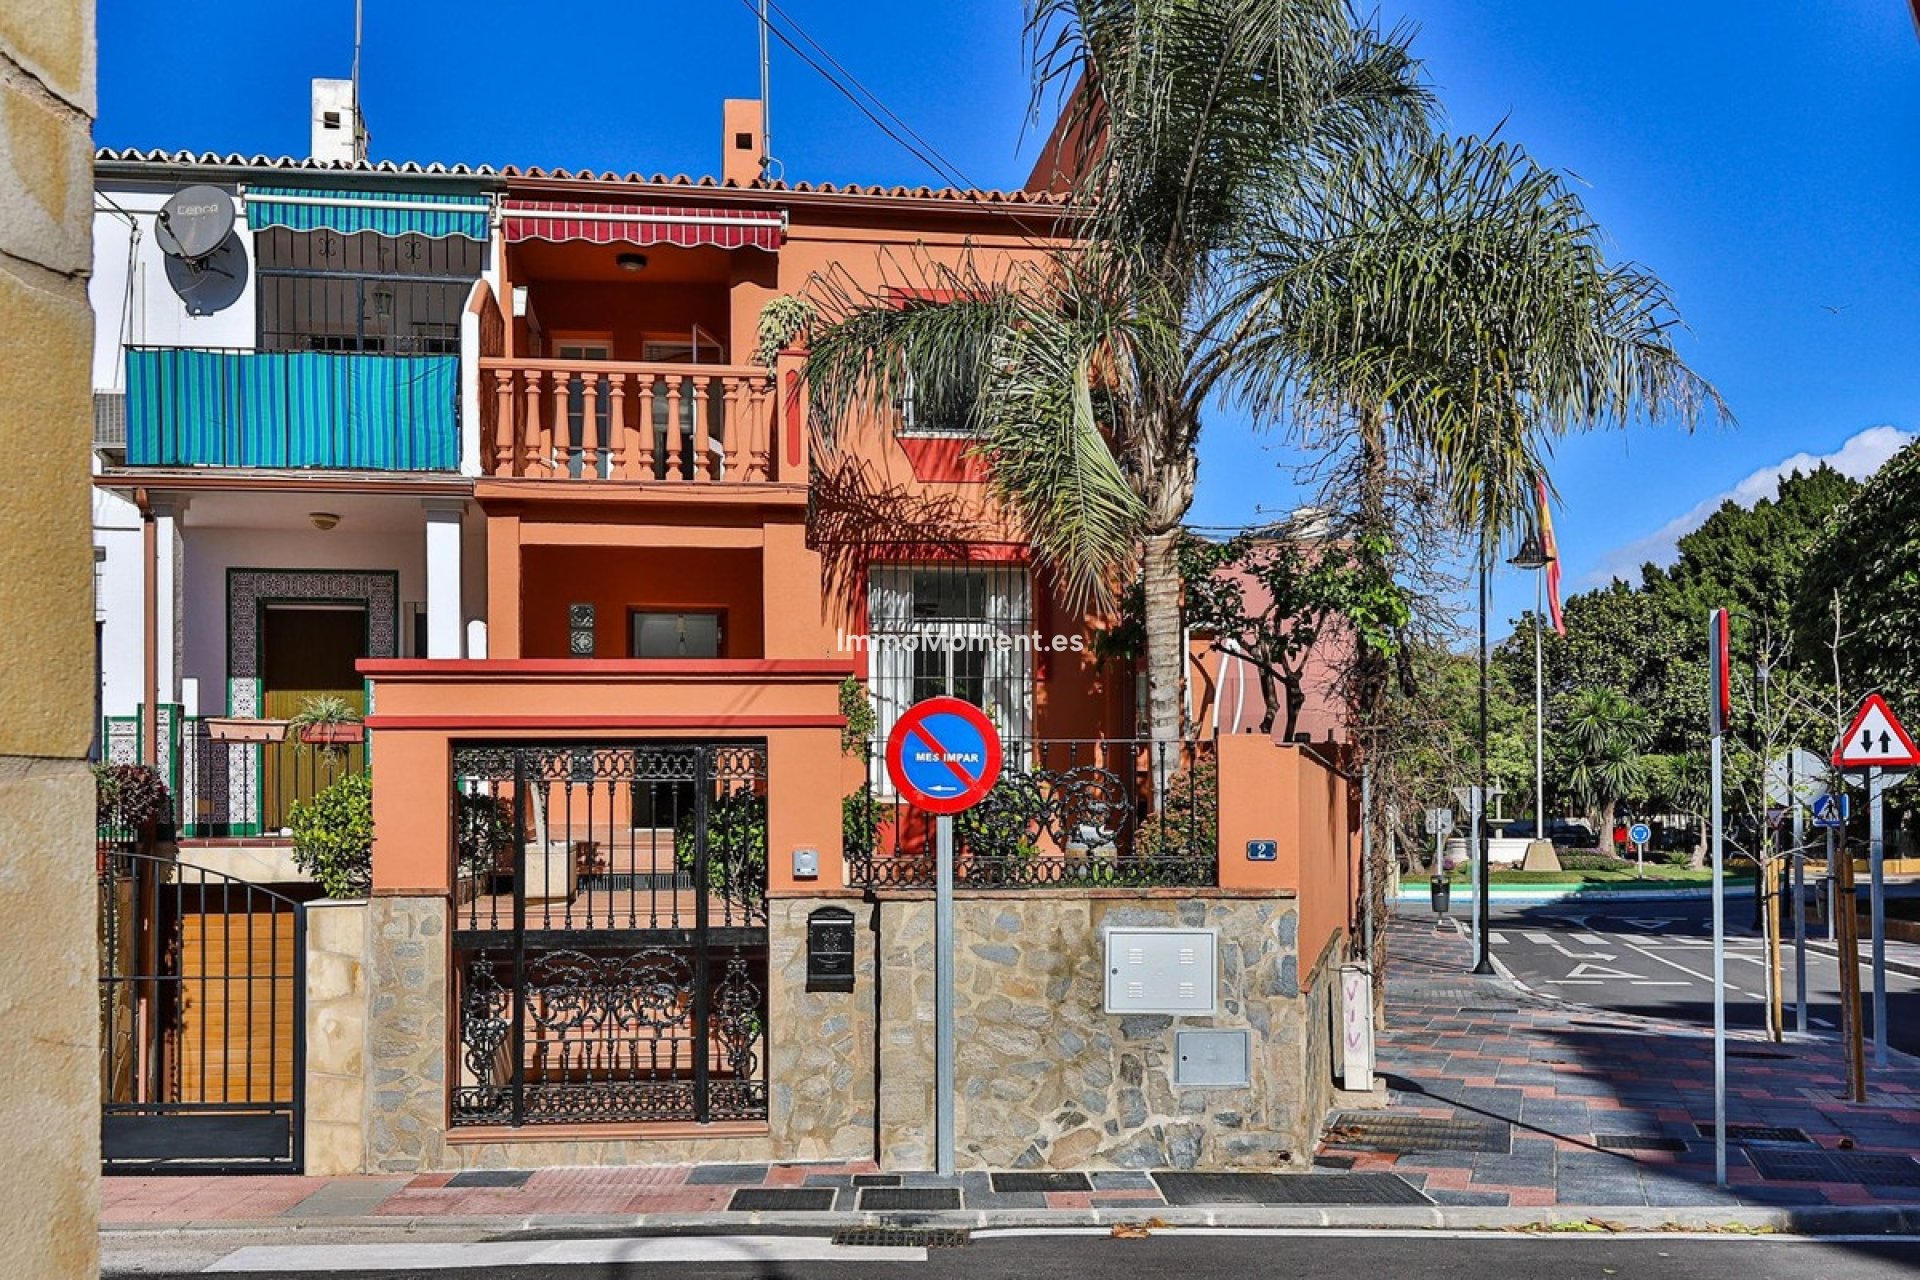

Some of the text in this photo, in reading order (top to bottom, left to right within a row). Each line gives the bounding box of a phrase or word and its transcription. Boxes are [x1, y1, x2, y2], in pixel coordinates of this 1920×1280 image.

[915, 752, 980, 763] MES IMPAR
[1257, 842, 1267, 858] 2
